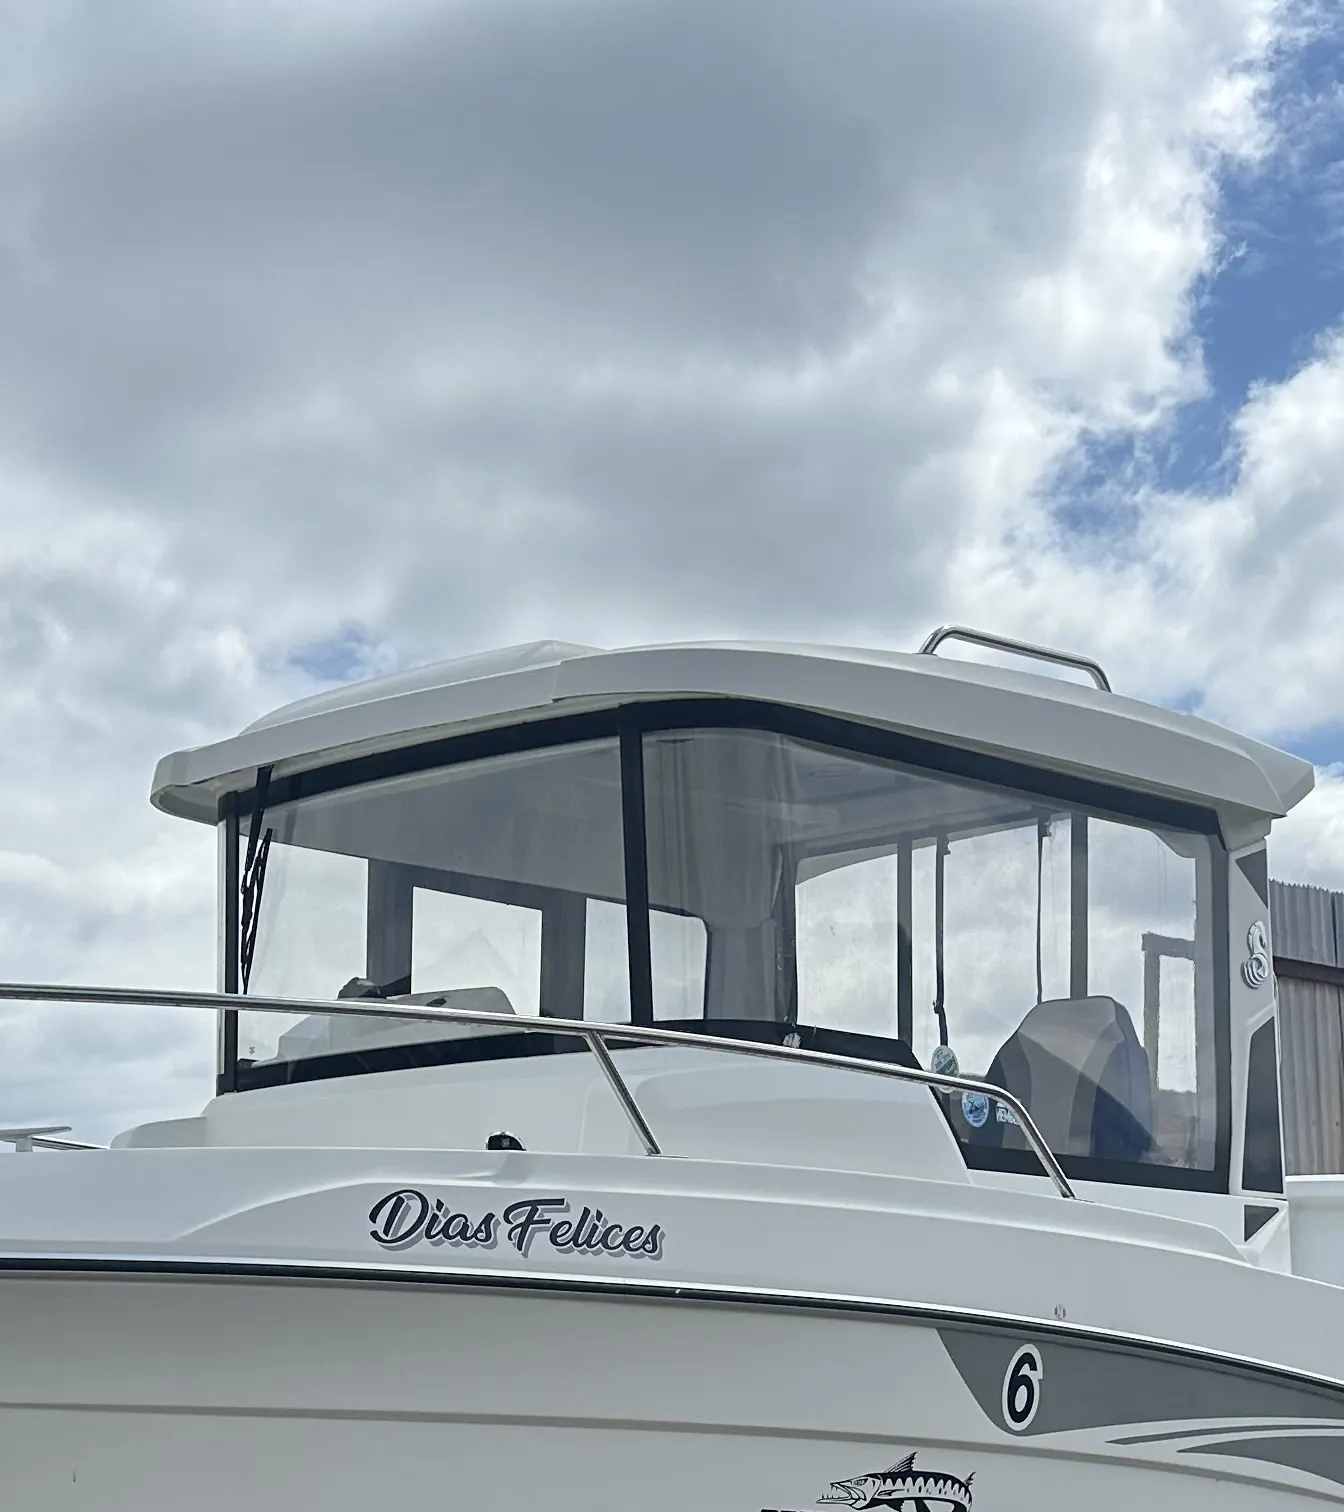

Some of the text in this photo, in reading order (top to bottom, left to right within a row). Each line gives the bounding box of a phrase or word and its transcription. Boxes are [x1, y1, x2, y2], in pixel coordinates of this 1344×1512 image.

[369, 1189, 665, 1259] Dias Felices
[1004, 1347, 1041, 1427] 6
